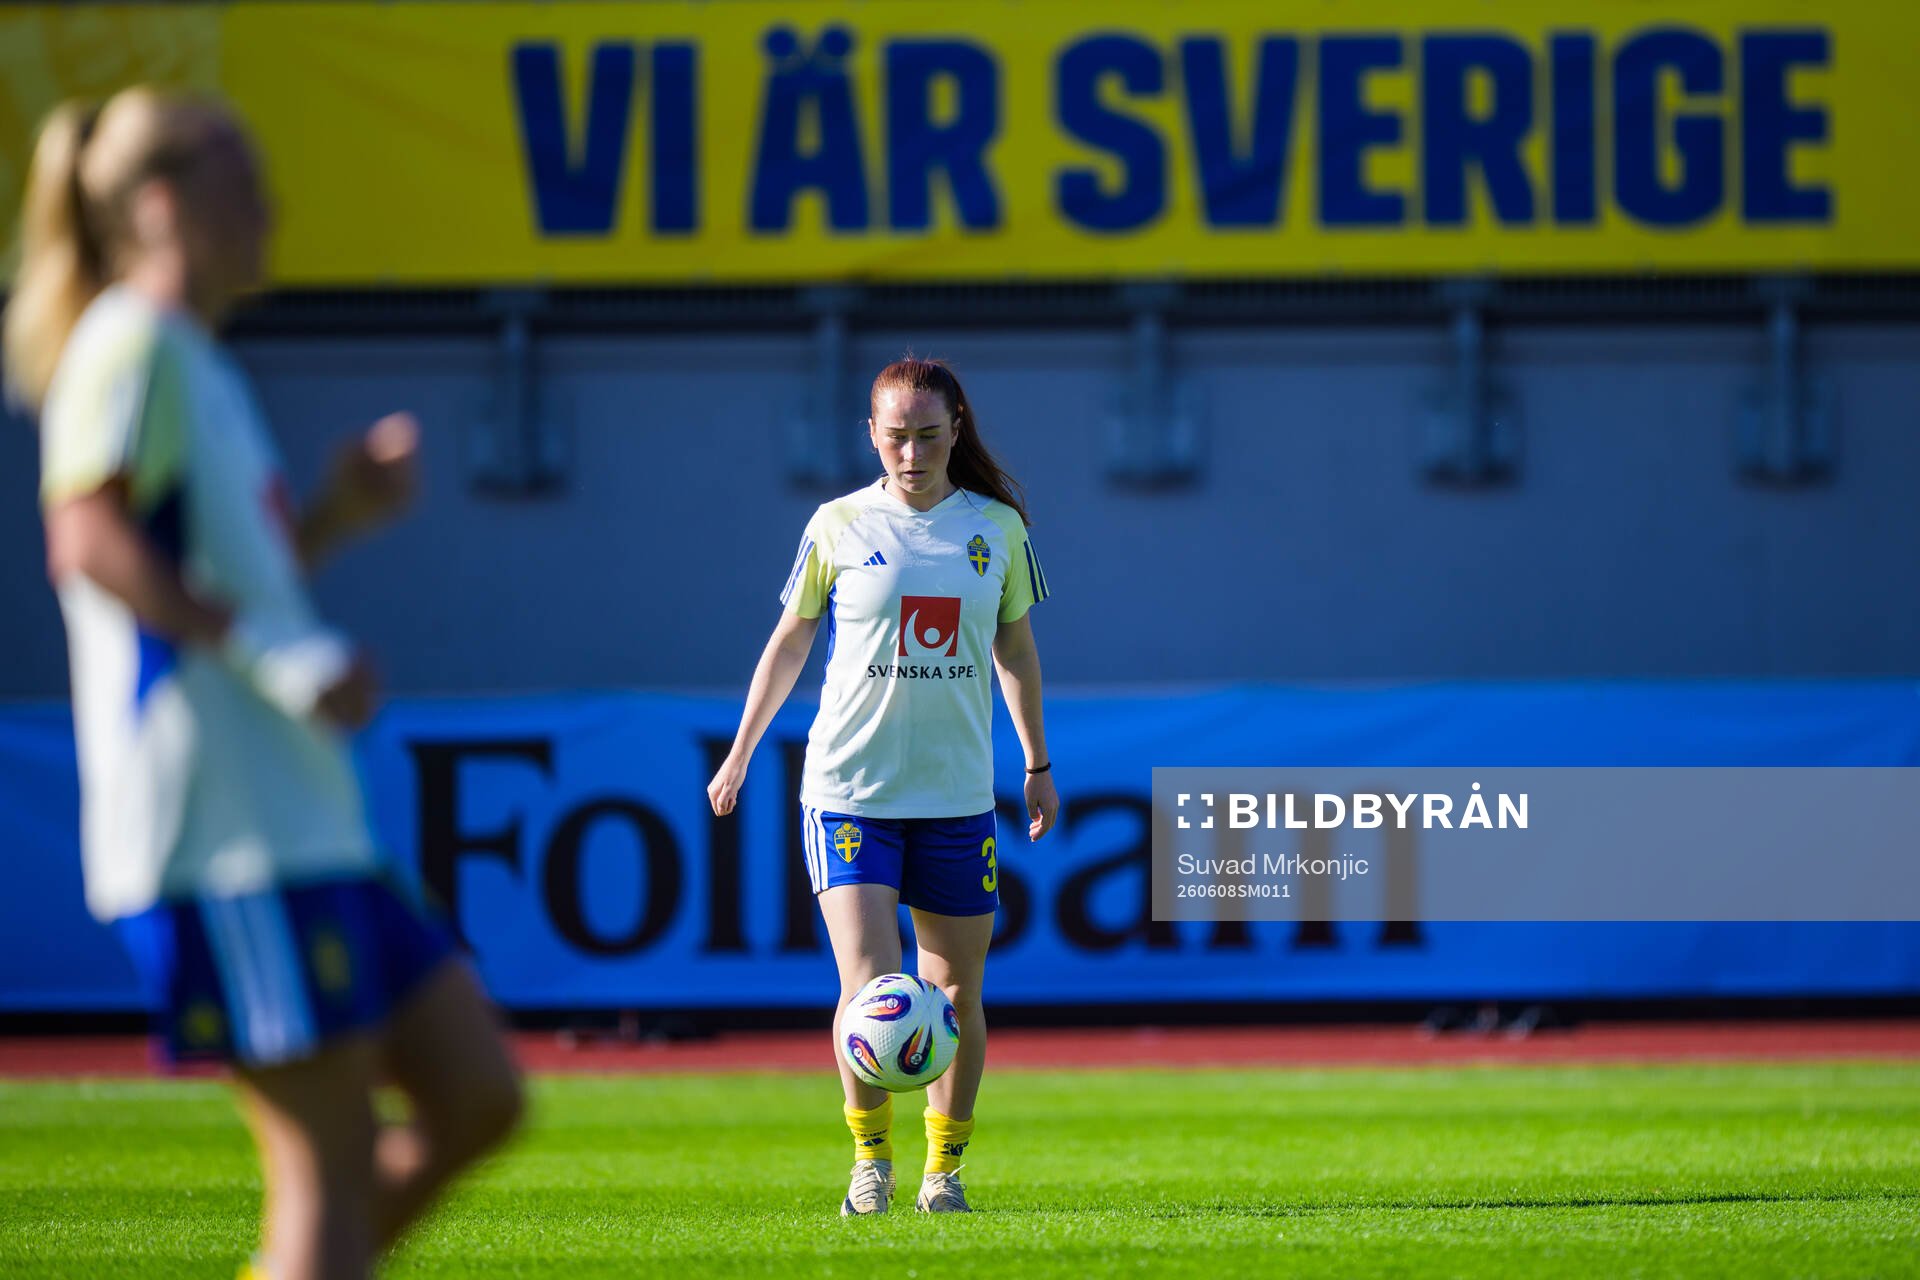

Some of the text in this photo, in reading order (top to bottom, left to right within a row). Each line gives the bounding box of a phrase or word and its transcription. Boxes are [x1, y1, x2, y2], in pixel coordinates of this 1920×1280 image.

[511, 25, 1835, 236] VI ÄR SVERIGE
[868, 664, 942, 679] SVENSKA
[405, 735, 1427, 958] Folam
[981, 836, 997, 893] 3
